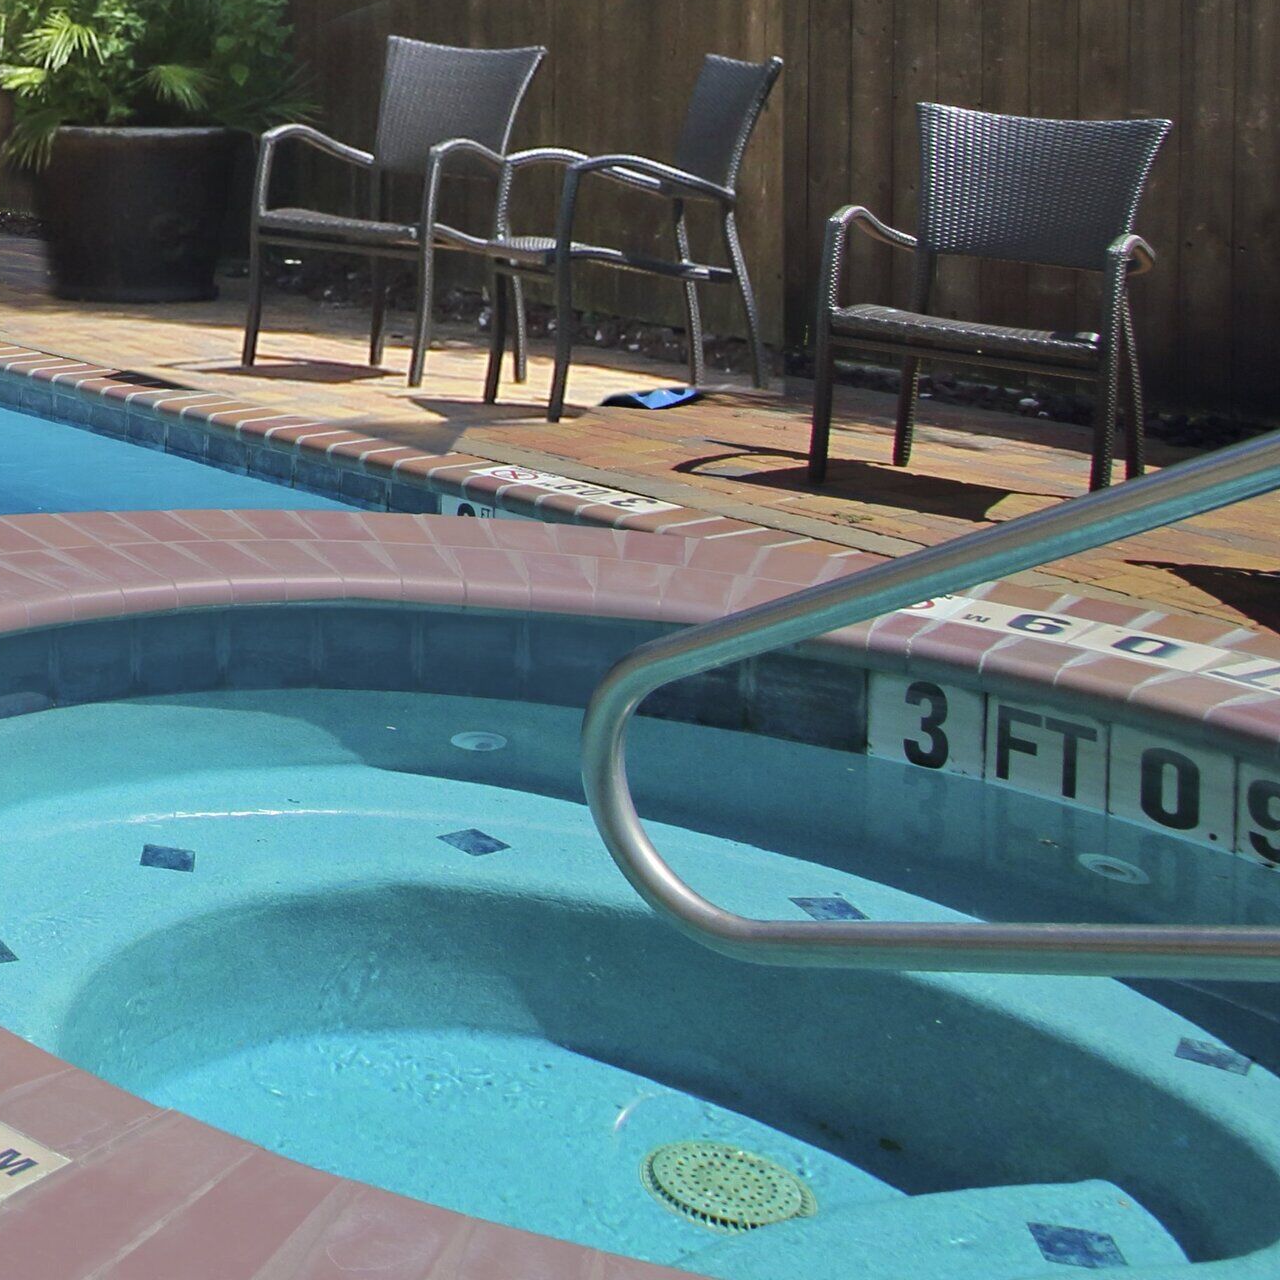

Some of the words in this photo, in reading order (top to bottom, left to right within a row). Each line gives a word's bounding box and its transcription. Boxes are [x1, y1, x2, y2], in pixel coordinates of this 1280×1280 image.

[610, 497, 657, 508] 3
[903, 681, 950, 770] 3
[996, 705, 1097, 800] FT
